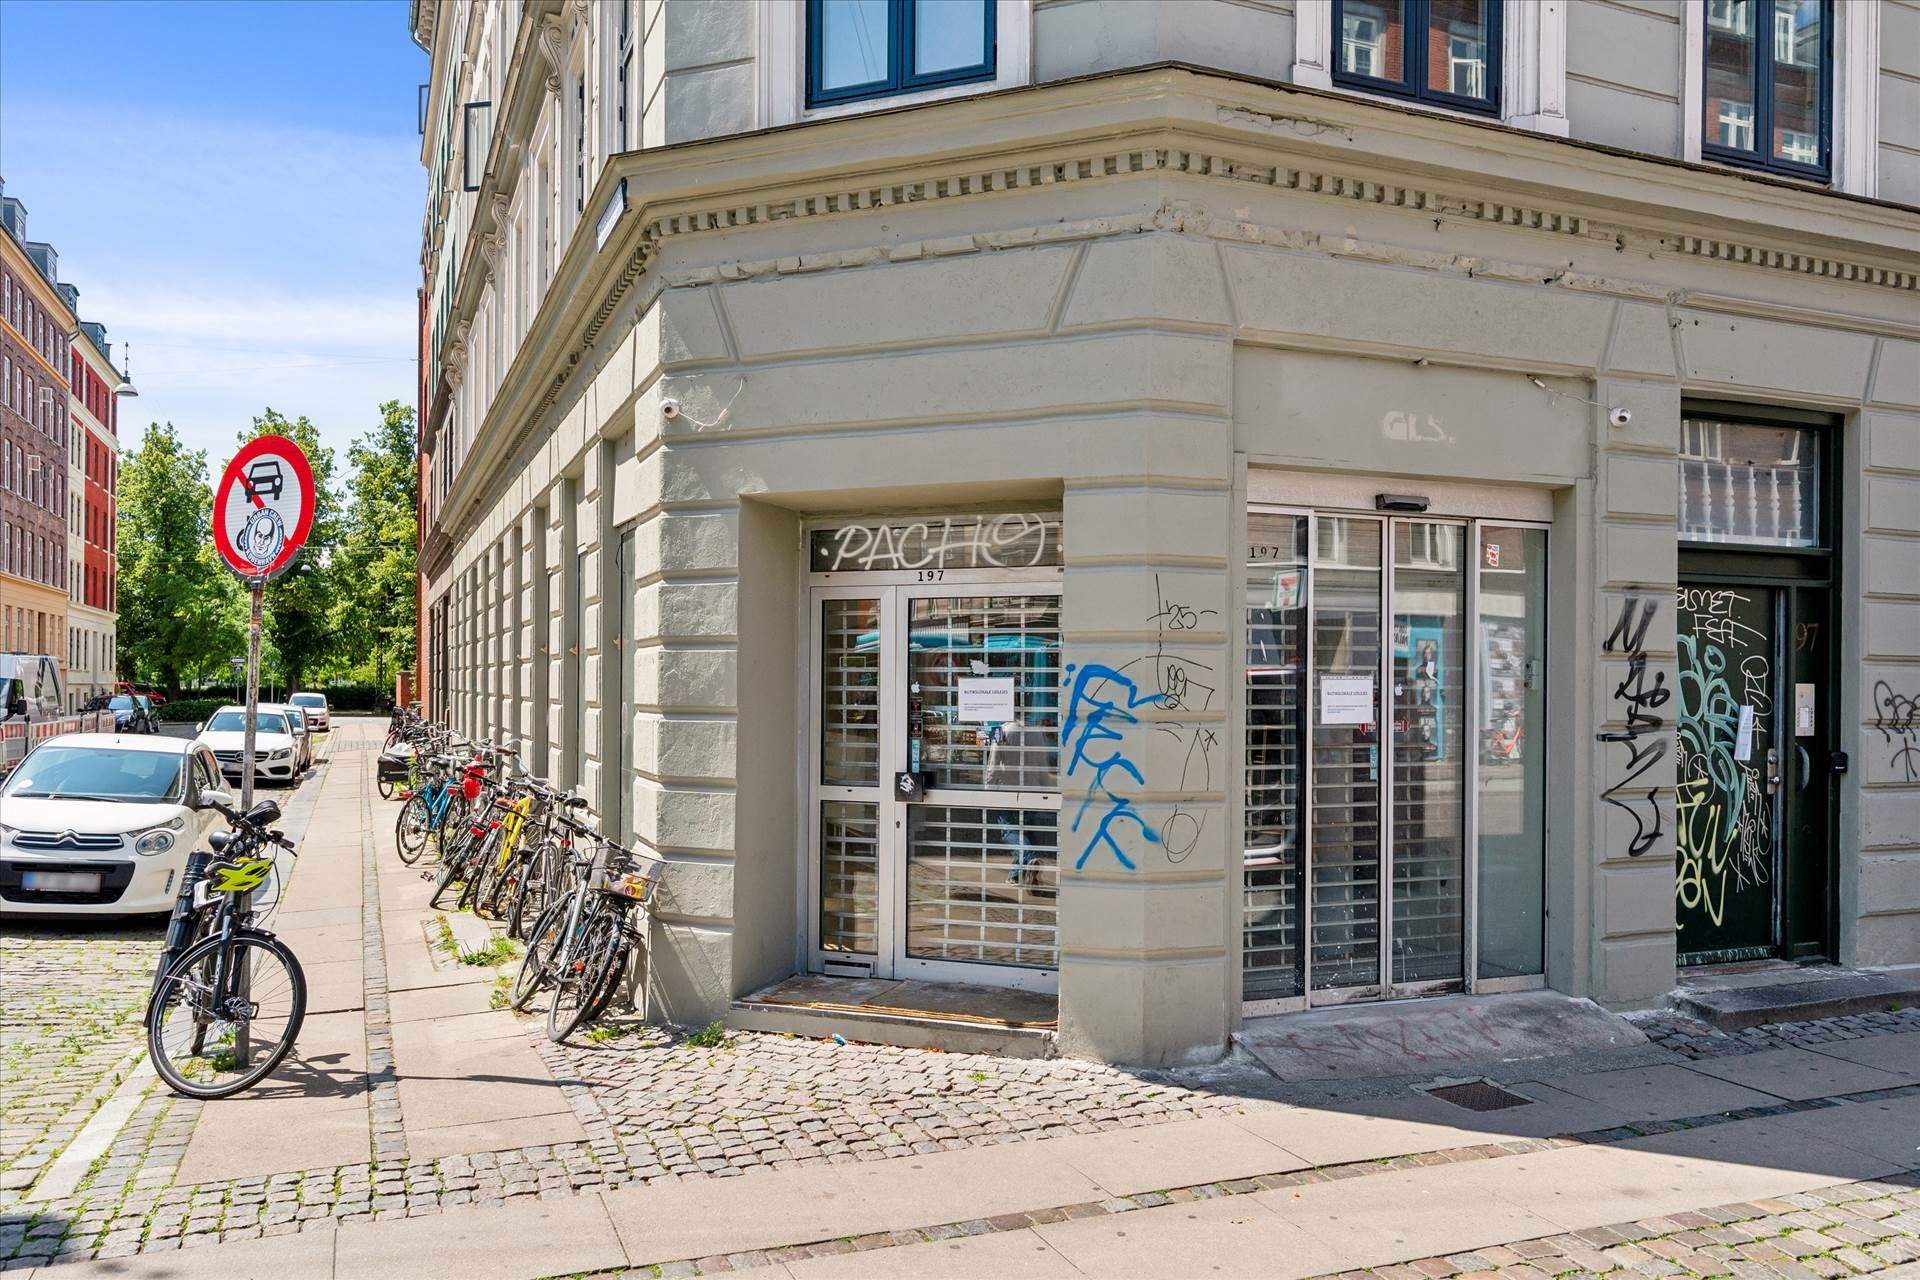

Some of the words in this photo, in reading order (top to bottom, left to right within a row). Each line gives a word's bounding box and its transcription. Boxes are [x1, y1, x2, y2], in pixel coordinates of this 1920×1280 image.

[250, 509, 269, 525] URBAN
[270, 510, 283, 526] CREW
[1249, 546, 1280, 560] 197
[917, 570, 945, 582] 197
